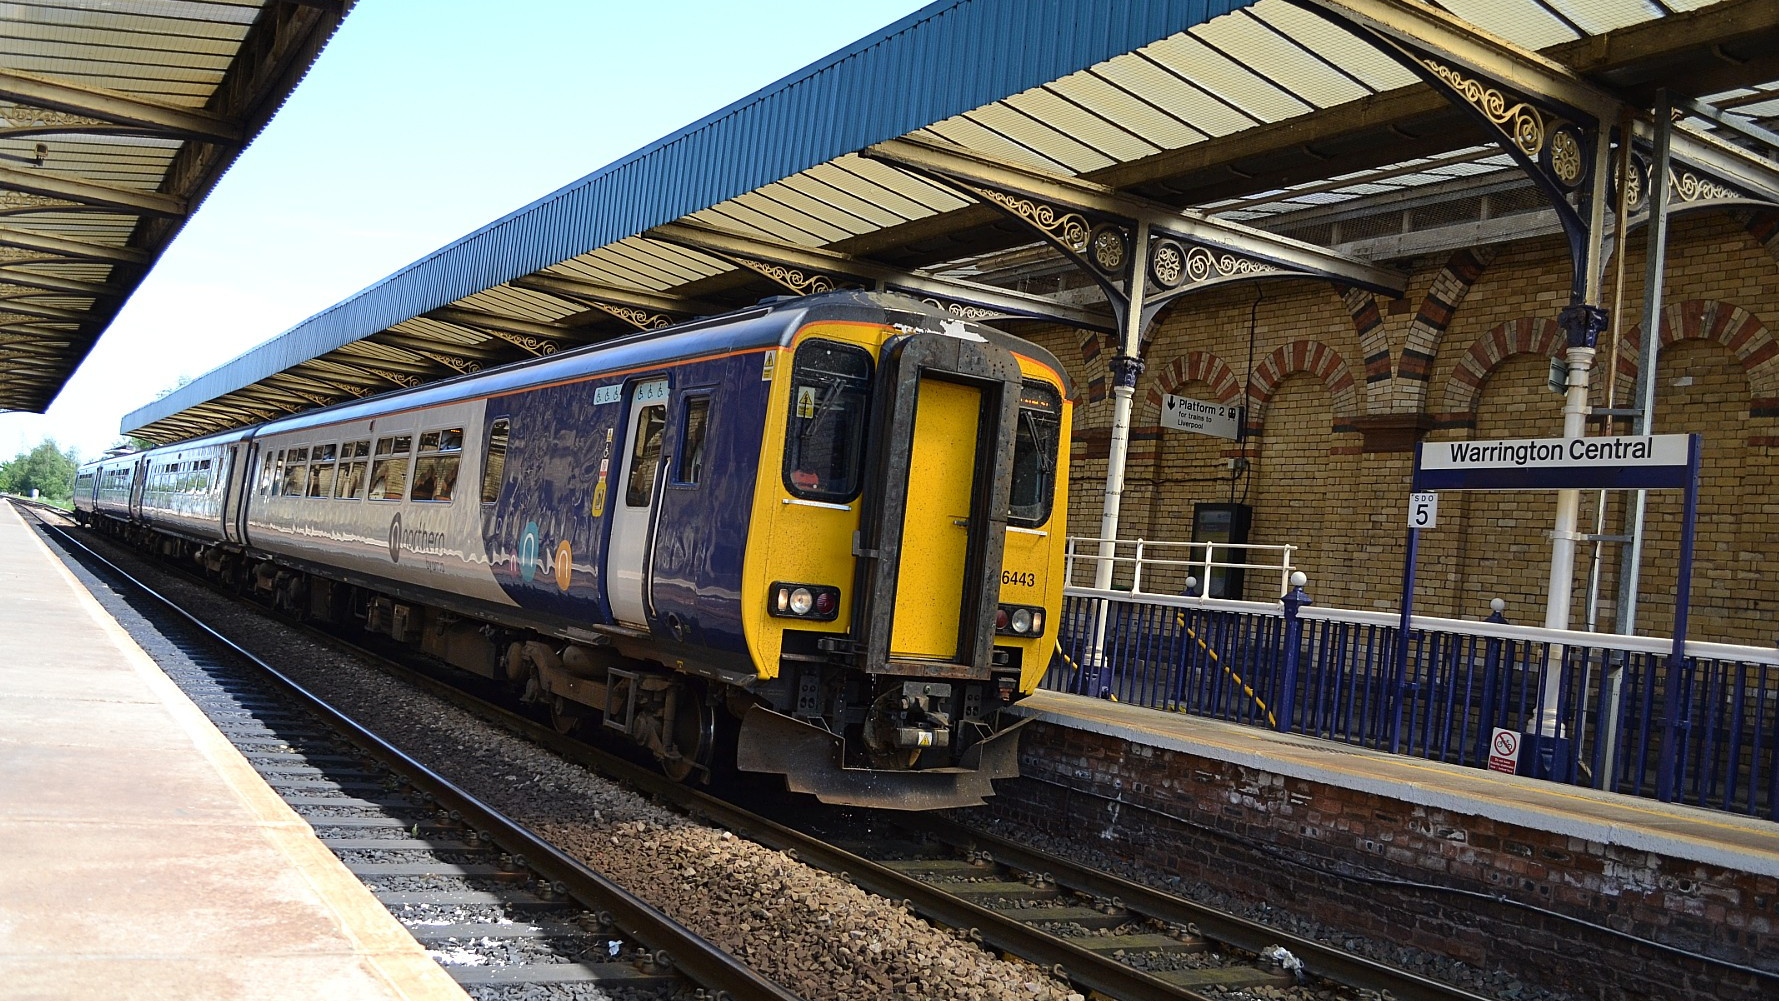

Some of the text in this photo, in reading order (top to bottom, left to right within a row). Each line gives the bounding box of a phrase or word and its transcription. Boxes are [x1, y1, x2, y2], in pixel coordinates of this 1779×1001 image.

[1179, 399, 1225, 417] Platform 2
[1188, 413, 1205, 422] trains
[1178, 419, 1204, 430] Liverpool
[1450, 437, 1653, 465] Warrington Central
[1415, 503, 1429, 525] 5
[402, 522, 445, 554] northern
